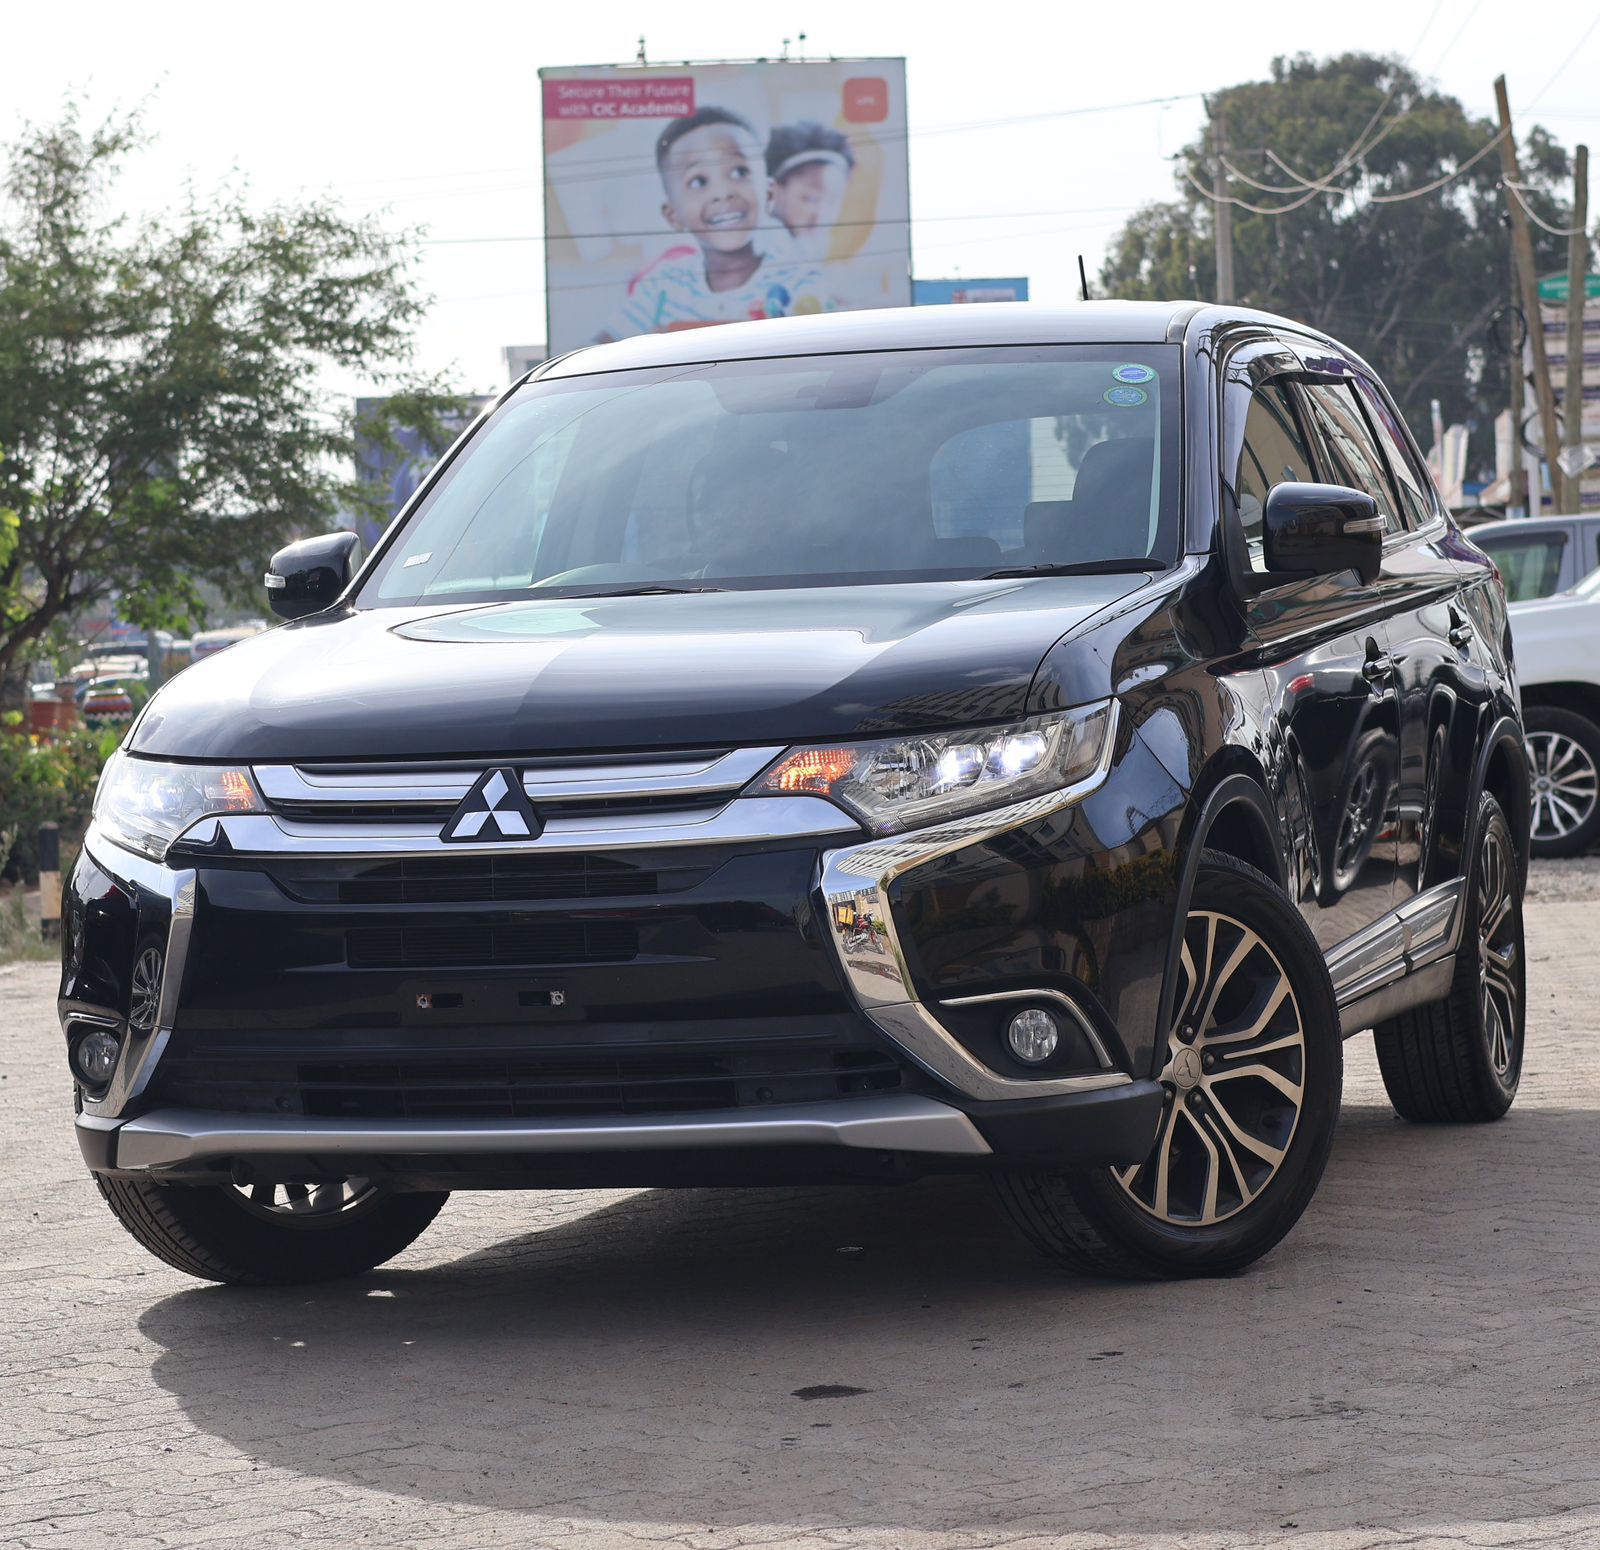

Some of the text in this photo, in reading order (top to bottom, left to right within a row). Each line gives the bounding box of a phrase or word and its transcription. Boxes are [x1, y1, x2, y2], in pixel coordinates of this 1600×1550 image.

[558, 84, 690, 98] Secure Their Future
[559, 101, 689, 116] with CIC Academia
